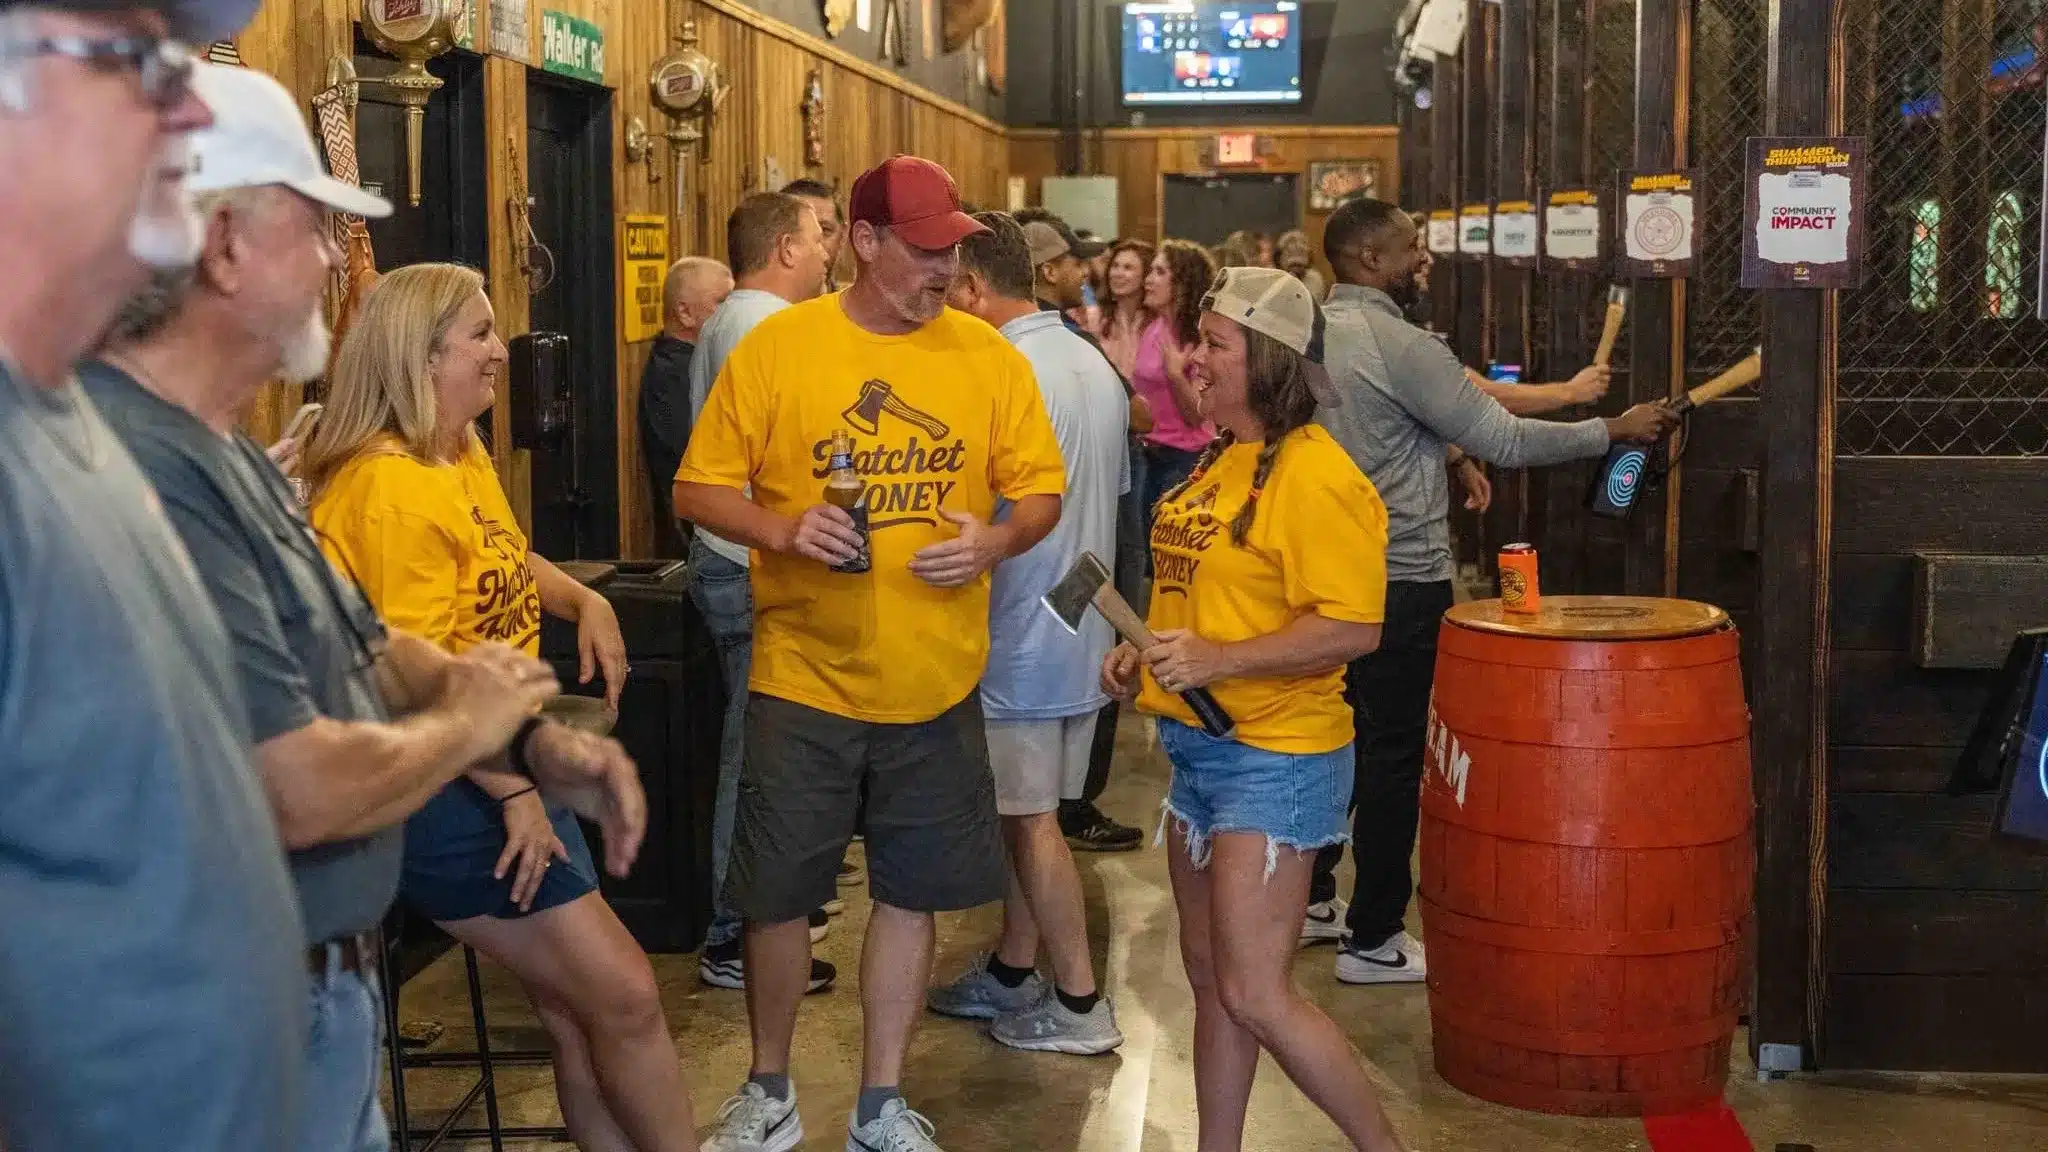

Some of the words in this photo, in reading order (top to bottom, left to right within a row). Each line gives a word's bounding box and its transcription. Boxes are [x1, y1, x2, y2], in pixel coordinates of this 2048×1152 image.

[543, 15, 588, 70] Walker
[1768, 146, 1836, 158] SUMMER
[1772, 207, 1836, 215] COMMUNITY
[1771, 217, 1836, 230] IMPACT
[858, 480, 957, 514] ONEY
